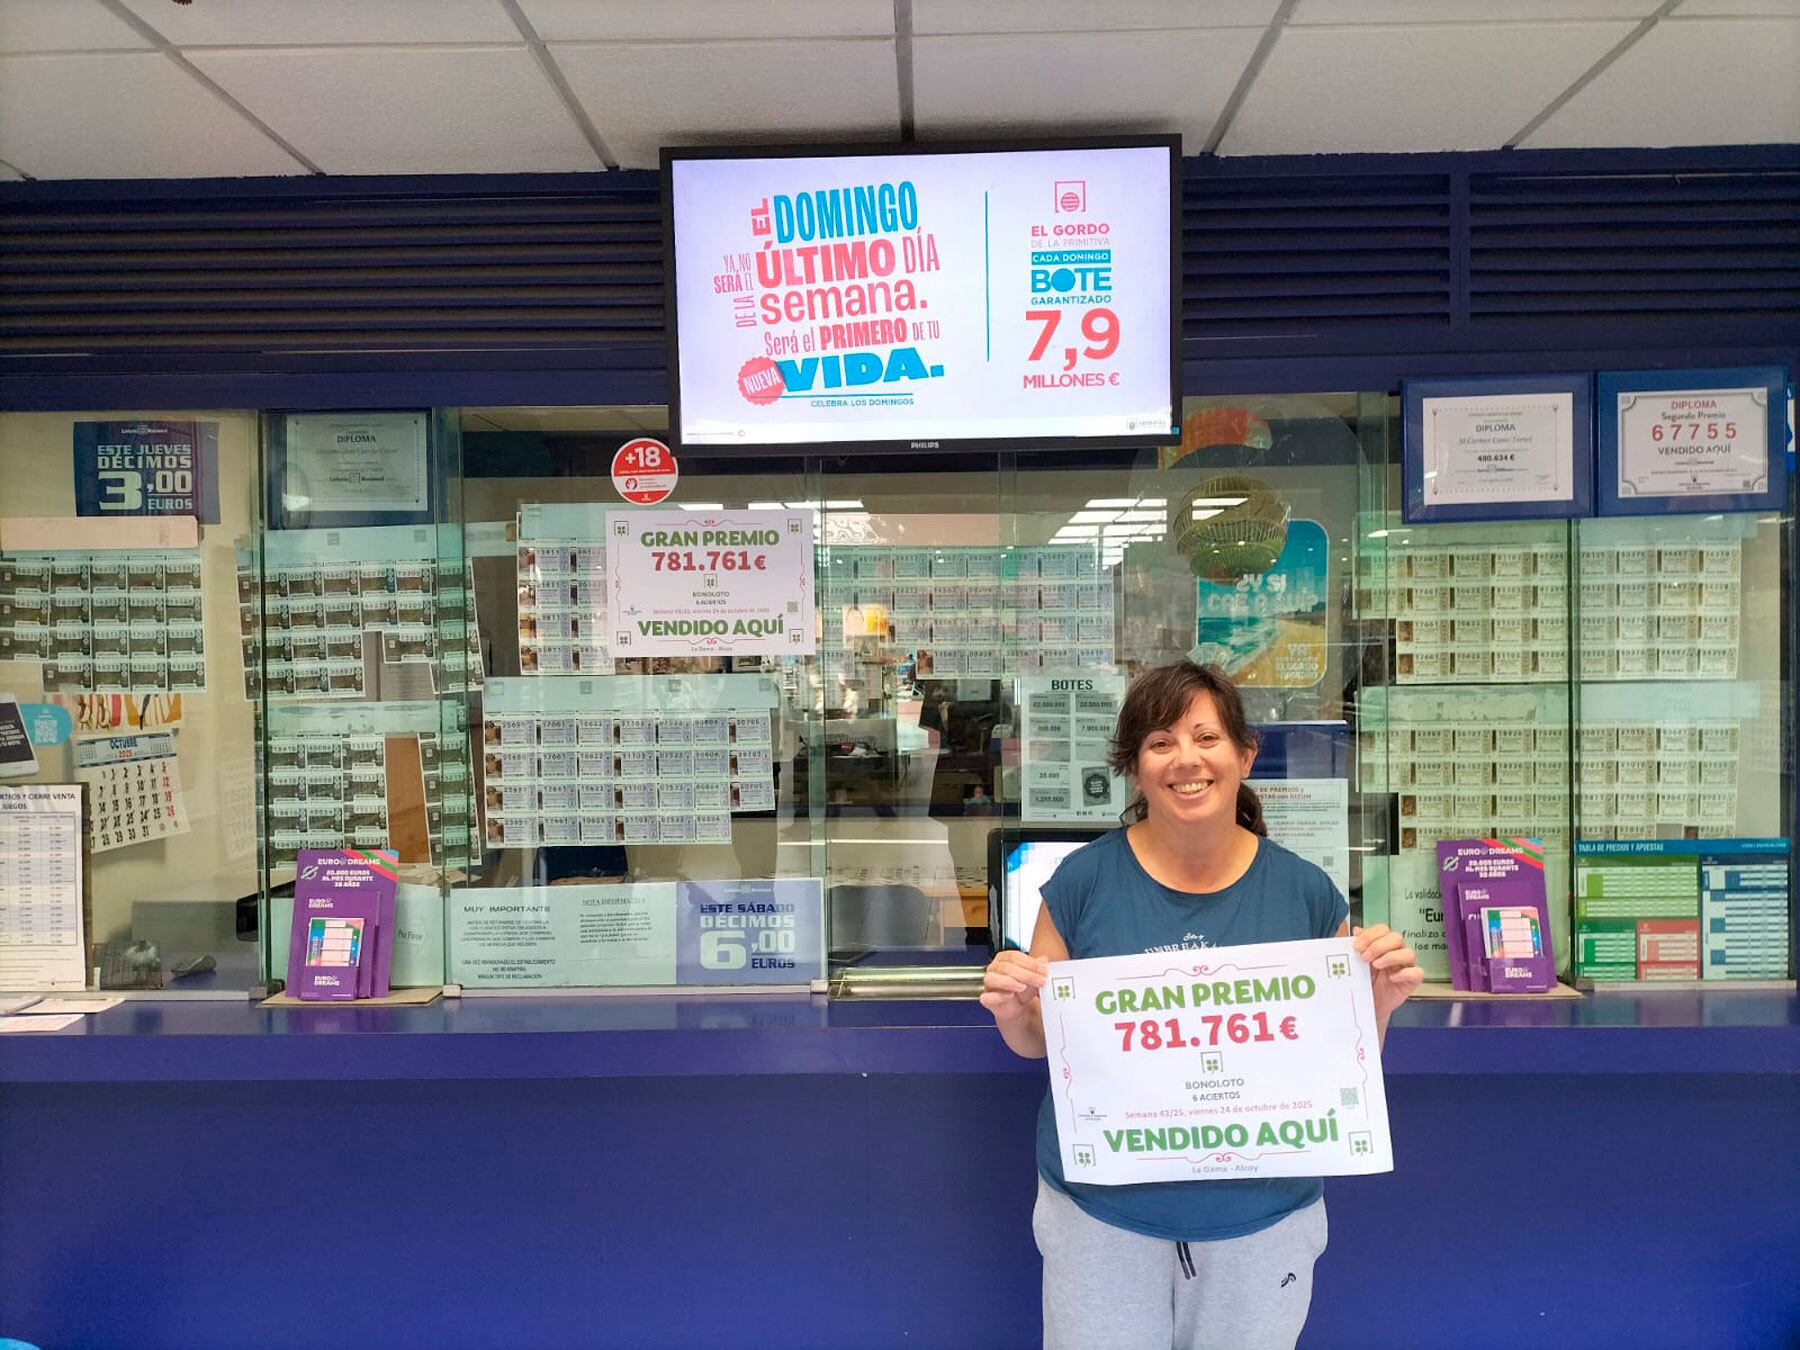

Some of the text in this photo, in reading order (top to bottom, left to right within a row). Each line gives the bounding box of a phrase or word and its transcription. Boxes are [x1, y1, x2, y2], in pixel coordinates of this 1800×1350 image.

[751, 198, 771, 236] EL
[773, 181, 918, 243] DOMINGO
[1031, 223, 1110, 237] EL GORDO
[1031, 238, 1111, 248] DE LA PRIMITIVA
[755, 226, 940, 288] ÚLTIMO DÍA
[1032, 253, 1109, 262] CADA DOMINGO
[713, 269, 742, 294] SERÁ
[1031, 267, 1112, 293] BOTE
[760, 279, 928, 325] semana.
[1031, 295, 1112, 305] GARANTIZADO
[764, 318, 941, 356] Será el PRIMERO DE TU
[1025, 307, 1120, 371] 7,9
[775, 347, 944, 393] VIDA.
[742, 365, 781, 394] NUEVA
[1023, 372, 1120, 388] MILLONES €
[810, 398, 914, 407] CELEBRA LOS DOMINGOS
[1671, 400, 1717, 410] DIPLOMA
[1661, 410, 1726, 423] Segundo Premio
[1475, 423, 1516, 433] DIPLOMA
[336, 435, 377, 443] DIPLOMA
[911, 441, 940, 449] PHILIPS
[97, 444, 191, 455] ESTE JUEVES
[625, 446, 661, 467] +18
[1658, 444, 1731, 456] VENDIDO AQUÍ
[98, 453, 192, 469] DÉCIMOS
[148, 498, 193, 510] EUROS
[640, 529, 780, 547] GRAN PREMIO
[637, 613, 784, 638] VENDIDO AQUÍ
[1051, 679, 1094, 691] BOTES
[1458, 847, 1523, 856] EURO DREAMS
[700, 902, 795, 913] ESTE SÁBADO
[700, 912, 795, 928] DÉCIMOS
[751, 958, 795, 969] EUROS
[1095, 975, 1317, 1015] GRAN PREMIO
[1185, 1078, 1245, 1090] BONOLOTO
[1192, 1091, 1241, 1102] 6 ACIERTOS
[1124, 1110, 1158, 1119] Semana
[1187, 1107, 1218, 1116] viernes
[1220, 1106, 1231, 1114] 24
[1232, 1105, 1242, 1114] de
[1245, 1103, 1277, 1113] octubre
[1279, 1101, 1290, 1110] de
[1292, 1100, 1313, 1109] 2025
[1103, 1108, 1339, 1152] VENDIDO AQUÍ
